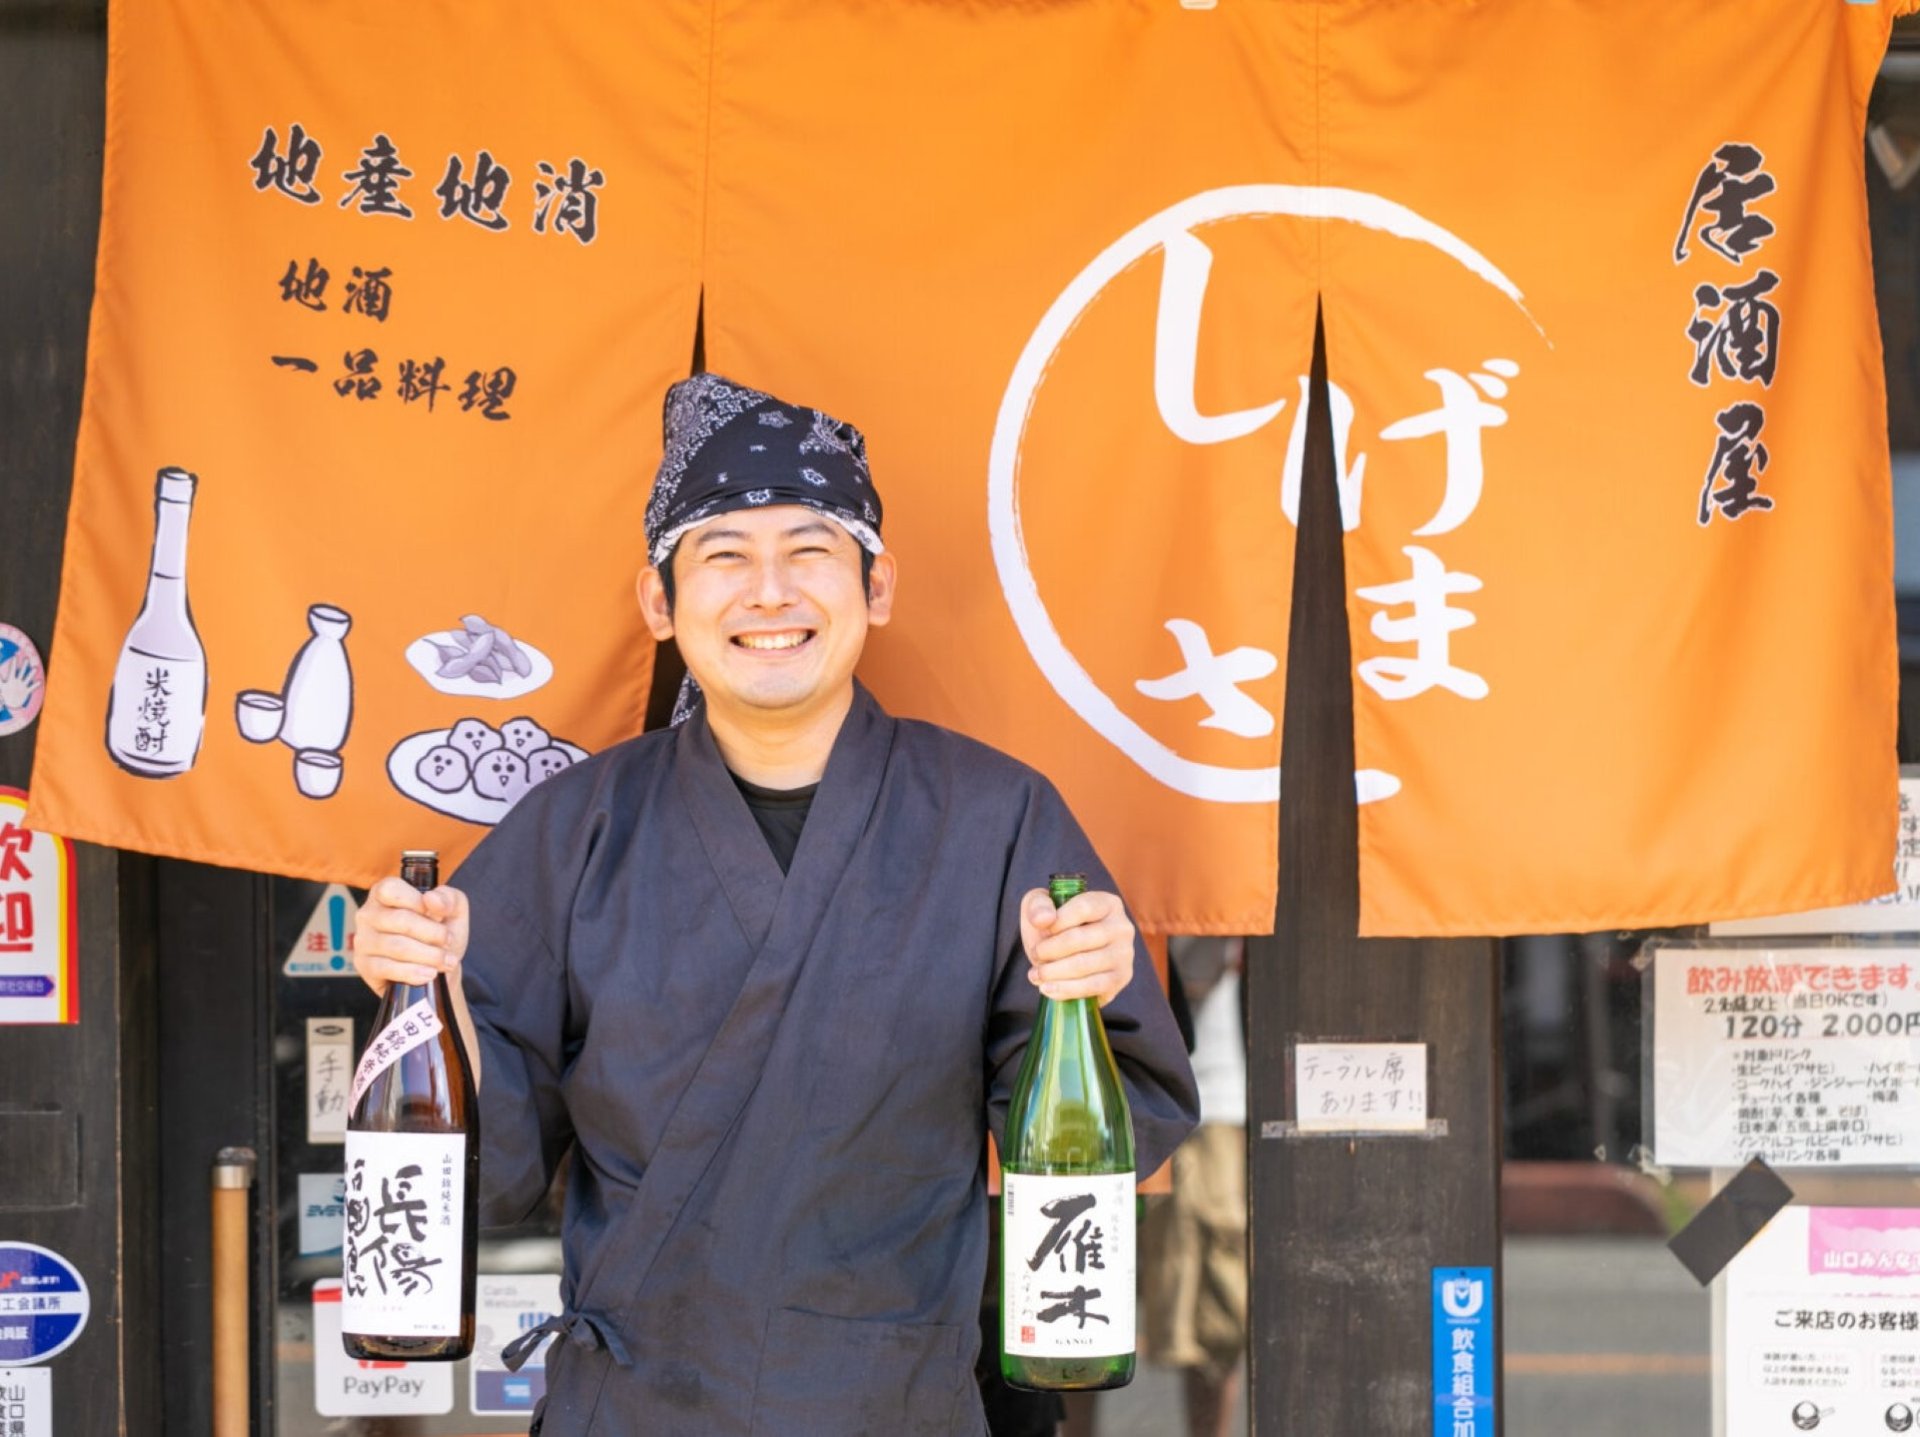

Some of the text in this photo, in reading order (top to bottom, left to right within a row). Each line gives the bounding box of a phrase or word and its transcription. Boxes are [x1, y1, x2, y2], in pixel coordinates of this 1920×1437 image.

[249, 123, 605, 245] 地産地消
[278, 257, 394, 322] 地酒
[1673, 141, 1780, 527] 居酒屋
[271, 347, 517, 421] 一品料理
[135, 666, 173, 756] 米焼酎
[1725, 1015, 1804, 1039] 120分
[315, 1049, 345, 1119] 手動
[1304, 1052, 1405, 1084] テーブル席
[1025, 1193, 1110, 1330] 雁木
[3, 1296, 61, 1311] 工会議所
[1774, 1308, 1919, 1331] ご来店のお客様
[343, 1375, 425, 1398] PayPay
